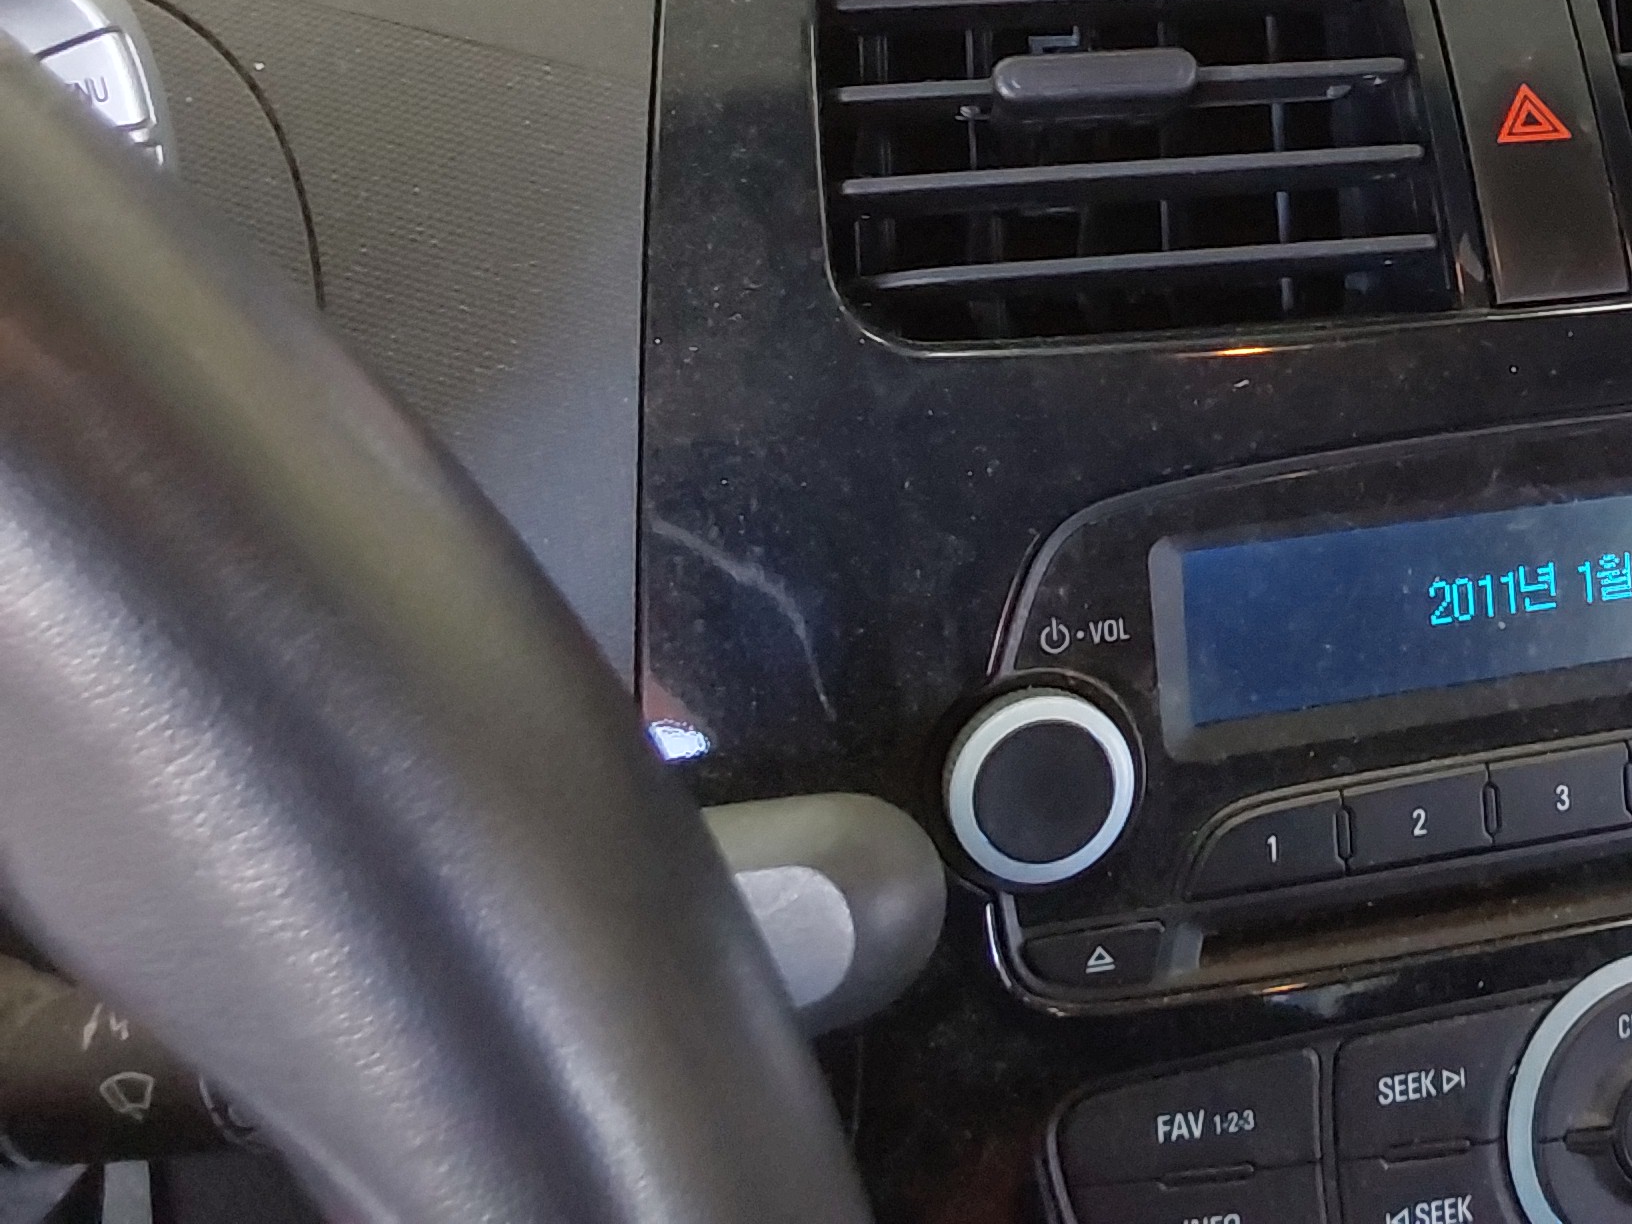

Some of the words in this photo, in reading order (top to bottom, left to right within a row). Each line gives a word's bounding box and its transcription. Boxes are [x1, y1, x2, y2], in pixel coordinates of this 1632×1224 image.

[1429, 561, 1557, 625] 2011년
[1088, 617, 1131, 645] VOL
[1555, 784, 1571, 812] 3
[1411, 808, 1429, 838] 2
[1266, 834, 1280, 864] 1
[1376, 1070, 1438, 1107] SEEK
[1155, 1108, 1206, 1145] FAV
[1414, 1194, 1474, 1224] SEEK
